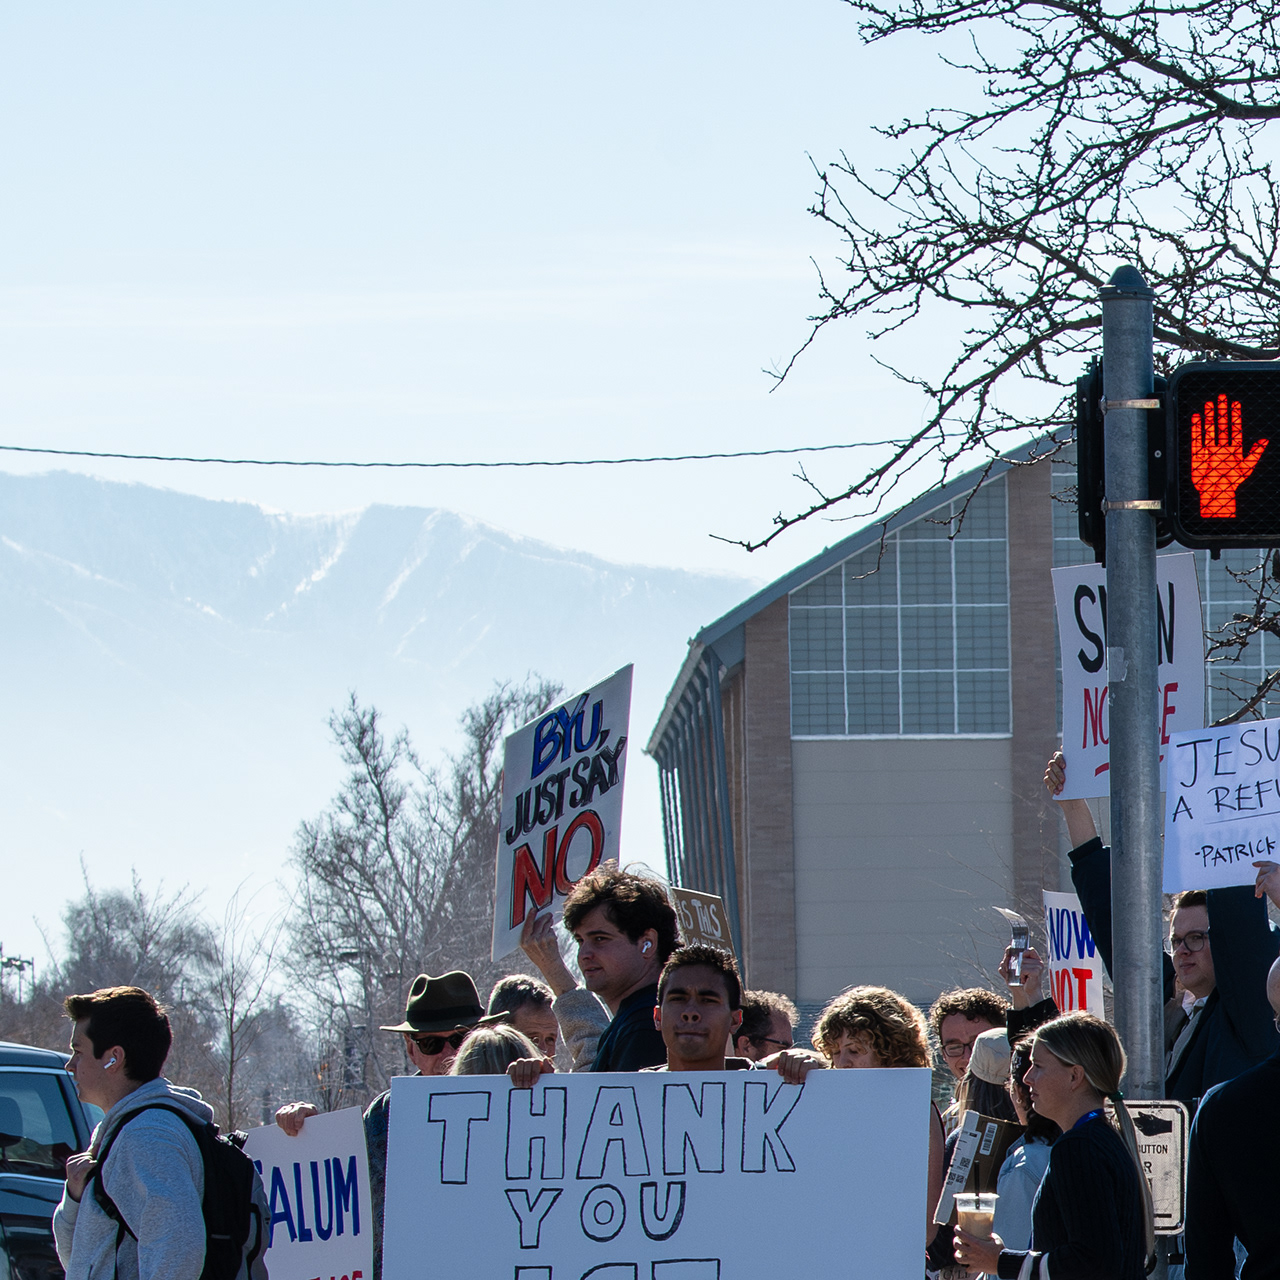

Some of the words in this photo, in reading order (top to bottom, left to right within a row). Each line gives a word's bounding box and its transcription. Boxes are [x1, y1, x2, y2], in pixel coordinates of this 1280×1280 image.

[531, 693, 611, 780] BYU,
[506, 767, 570, 845] JUST
[569, 736, 627, 808] SAY
[1172, 796, 1194, 823] A
[510, 810, 605, 930] NO
[1045, 905, 1096, 962] NOW
[427, 1081, 806, 1185] THANK
[505, 1181, 687, 1249] YOU
